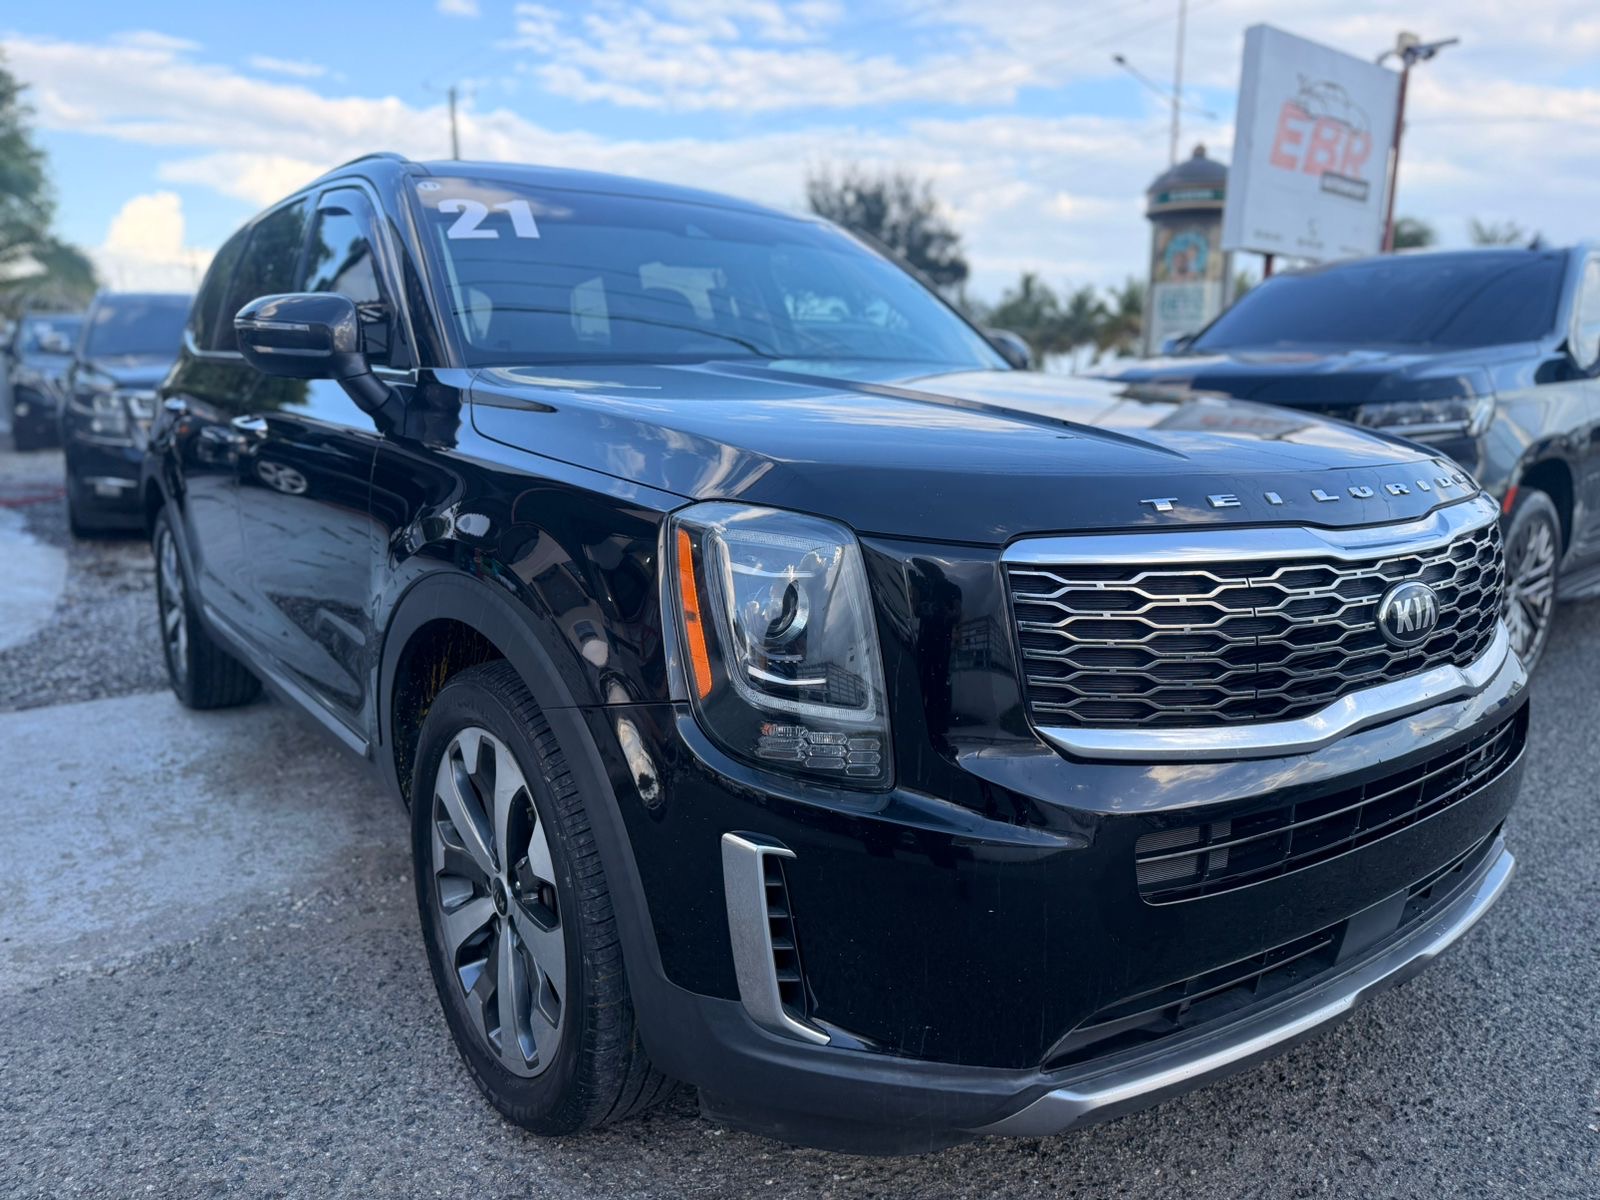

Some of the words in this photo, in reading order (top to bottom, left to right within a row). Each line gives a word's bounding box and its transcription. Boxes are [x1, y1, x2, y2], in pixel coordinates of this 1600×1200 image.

[1269, 98, 1373, 181] EBR
[438, 199, 540, 239] 21
[1393, 594, 1437, 634] KIA
